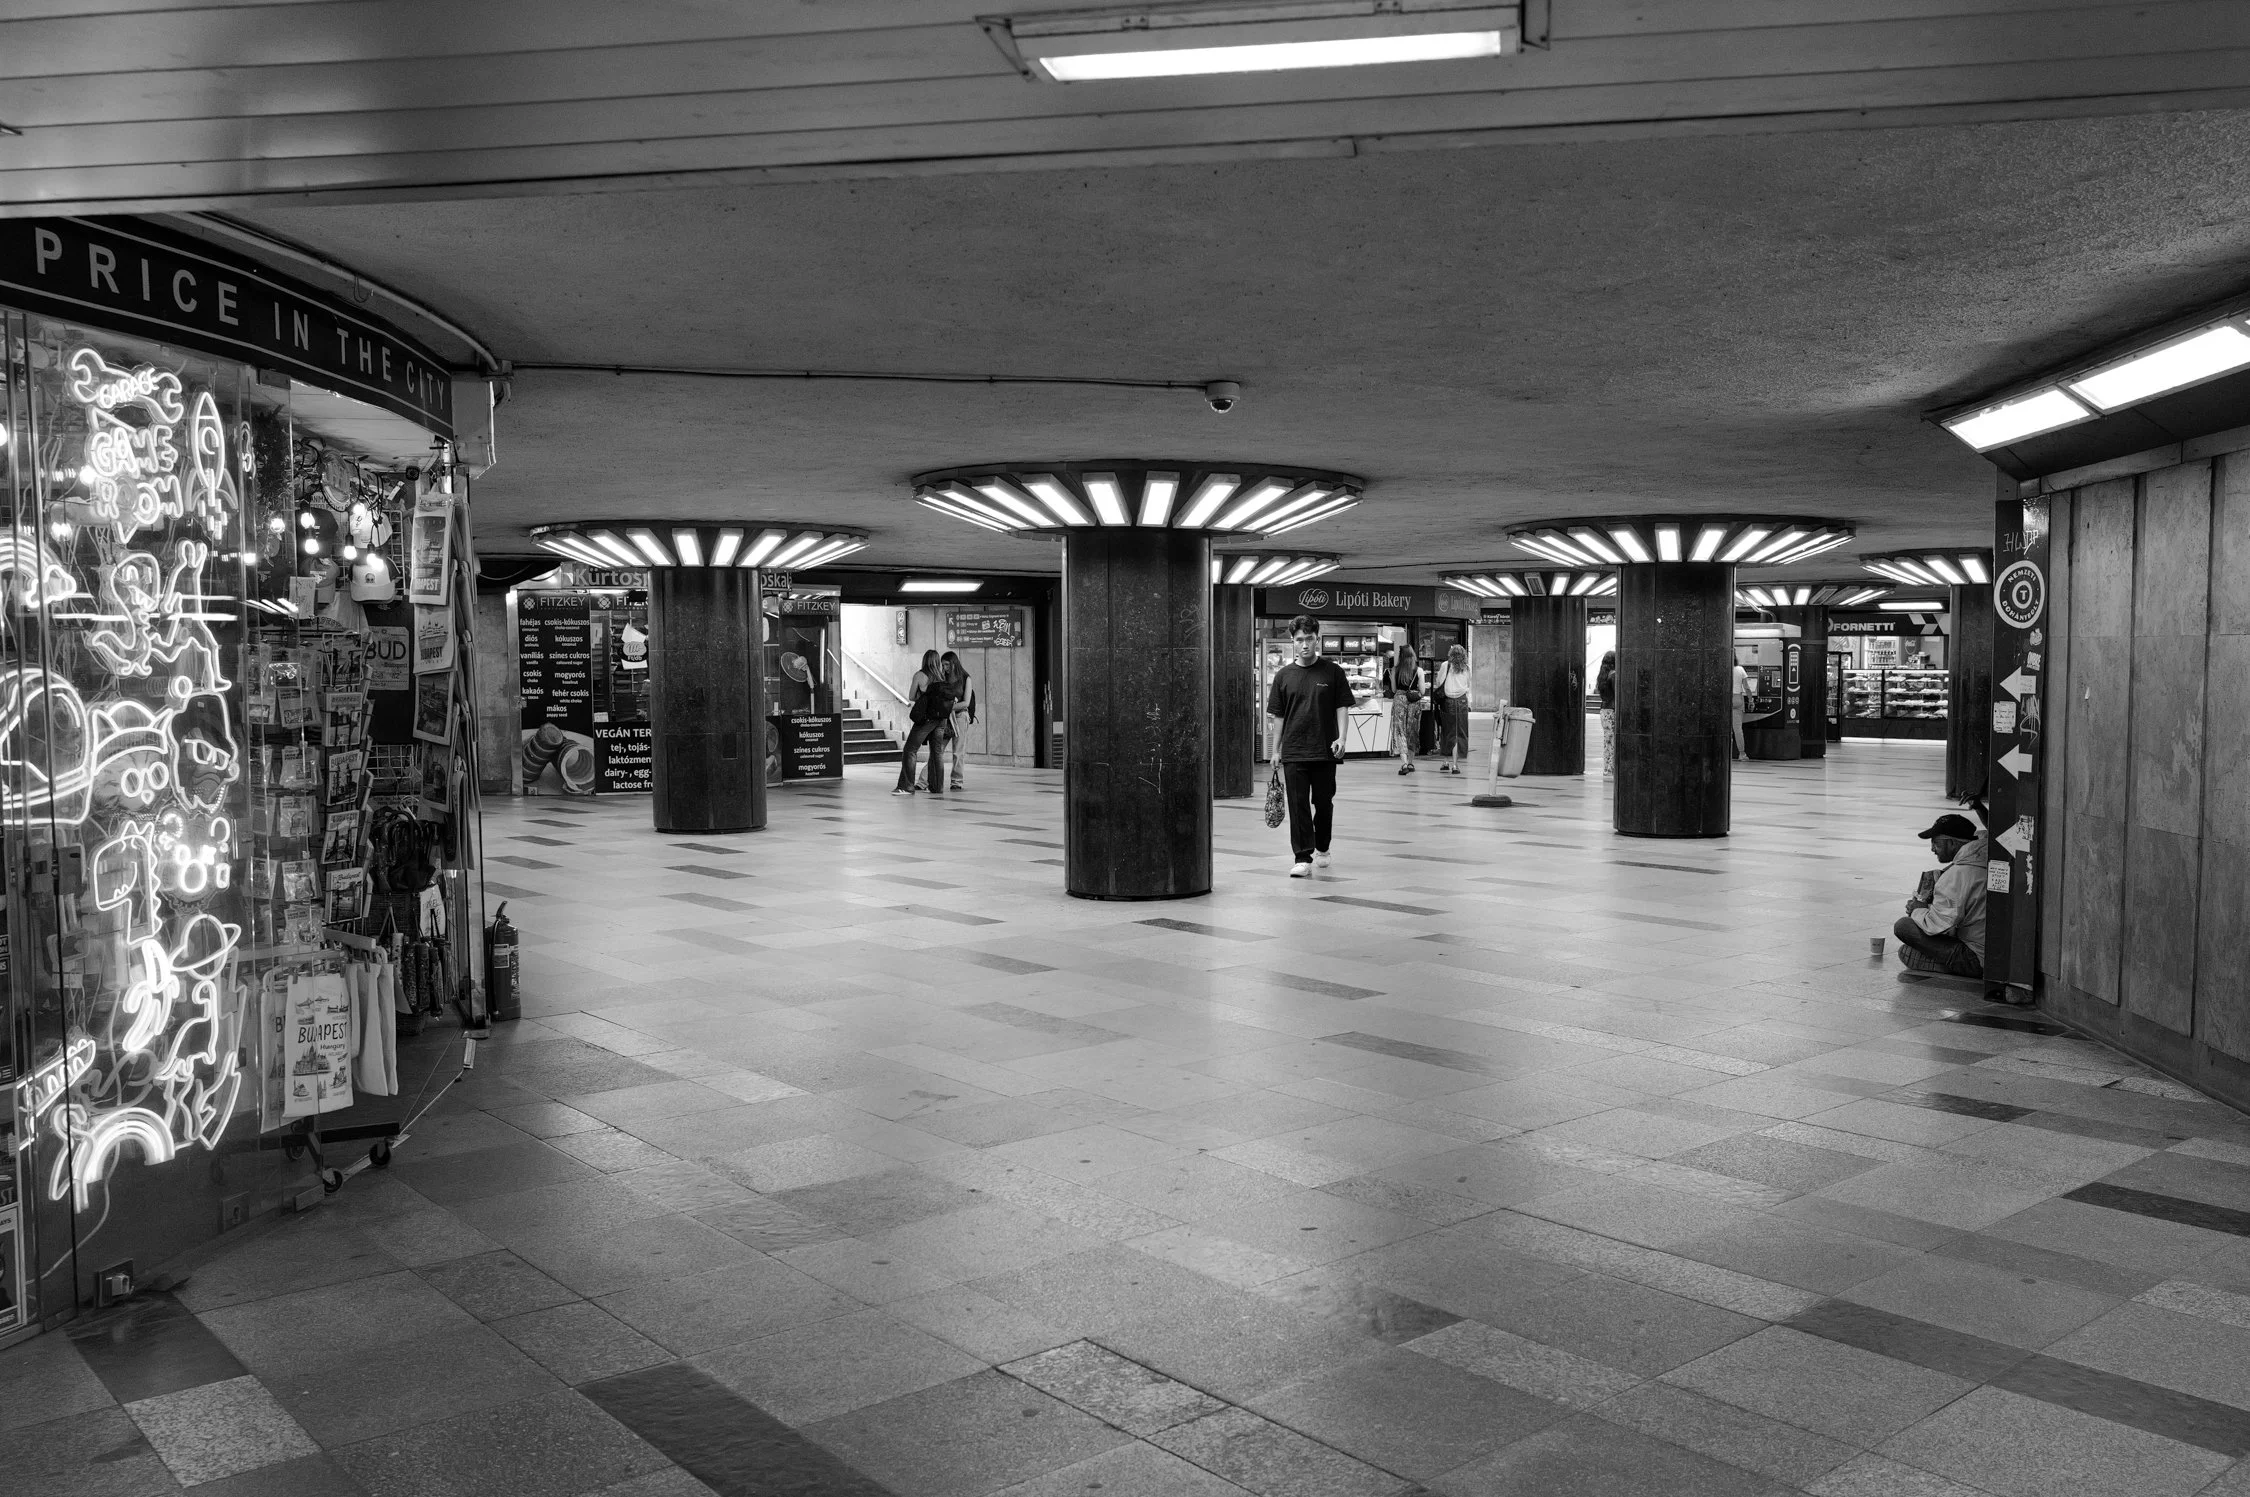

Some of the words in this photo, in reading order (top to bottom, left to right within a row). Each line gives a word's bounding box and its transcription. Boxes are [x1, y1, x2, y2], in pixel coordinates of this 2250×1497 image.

[35, 227, 239, 326] PRICE
[274, 302, 309, 351] IN
[336, 327, 392, 383] THE
[406, 360, 444, 410] CITY
[97, 368, 160, 408] GARAGE
[91, 425, 179, 479] GAME
[92, 475, 184, 525] ROOM
[2008, 569, 2036, 583] NEMZETI
[1336, 591, 1369, 609] Lipóti
[1373, 592, 1411, 611] Bakery
[2020, 590, 2027, 601] T
[540, 596, 586, 607] FITZKEY
[797, 601, 836, 611] FITZKEY
[1834, 622, 1894, 632] FORNETTI
[364, 640, 407, 660] BUD
[595, 727, 631, 738] VEGÁN
[628, 742, 651, 754] tojás-
[608, 755, 652, 765] laktózmen
[633, 768, 652, 779] egg-
[613, 780, 643, 789] lactose
